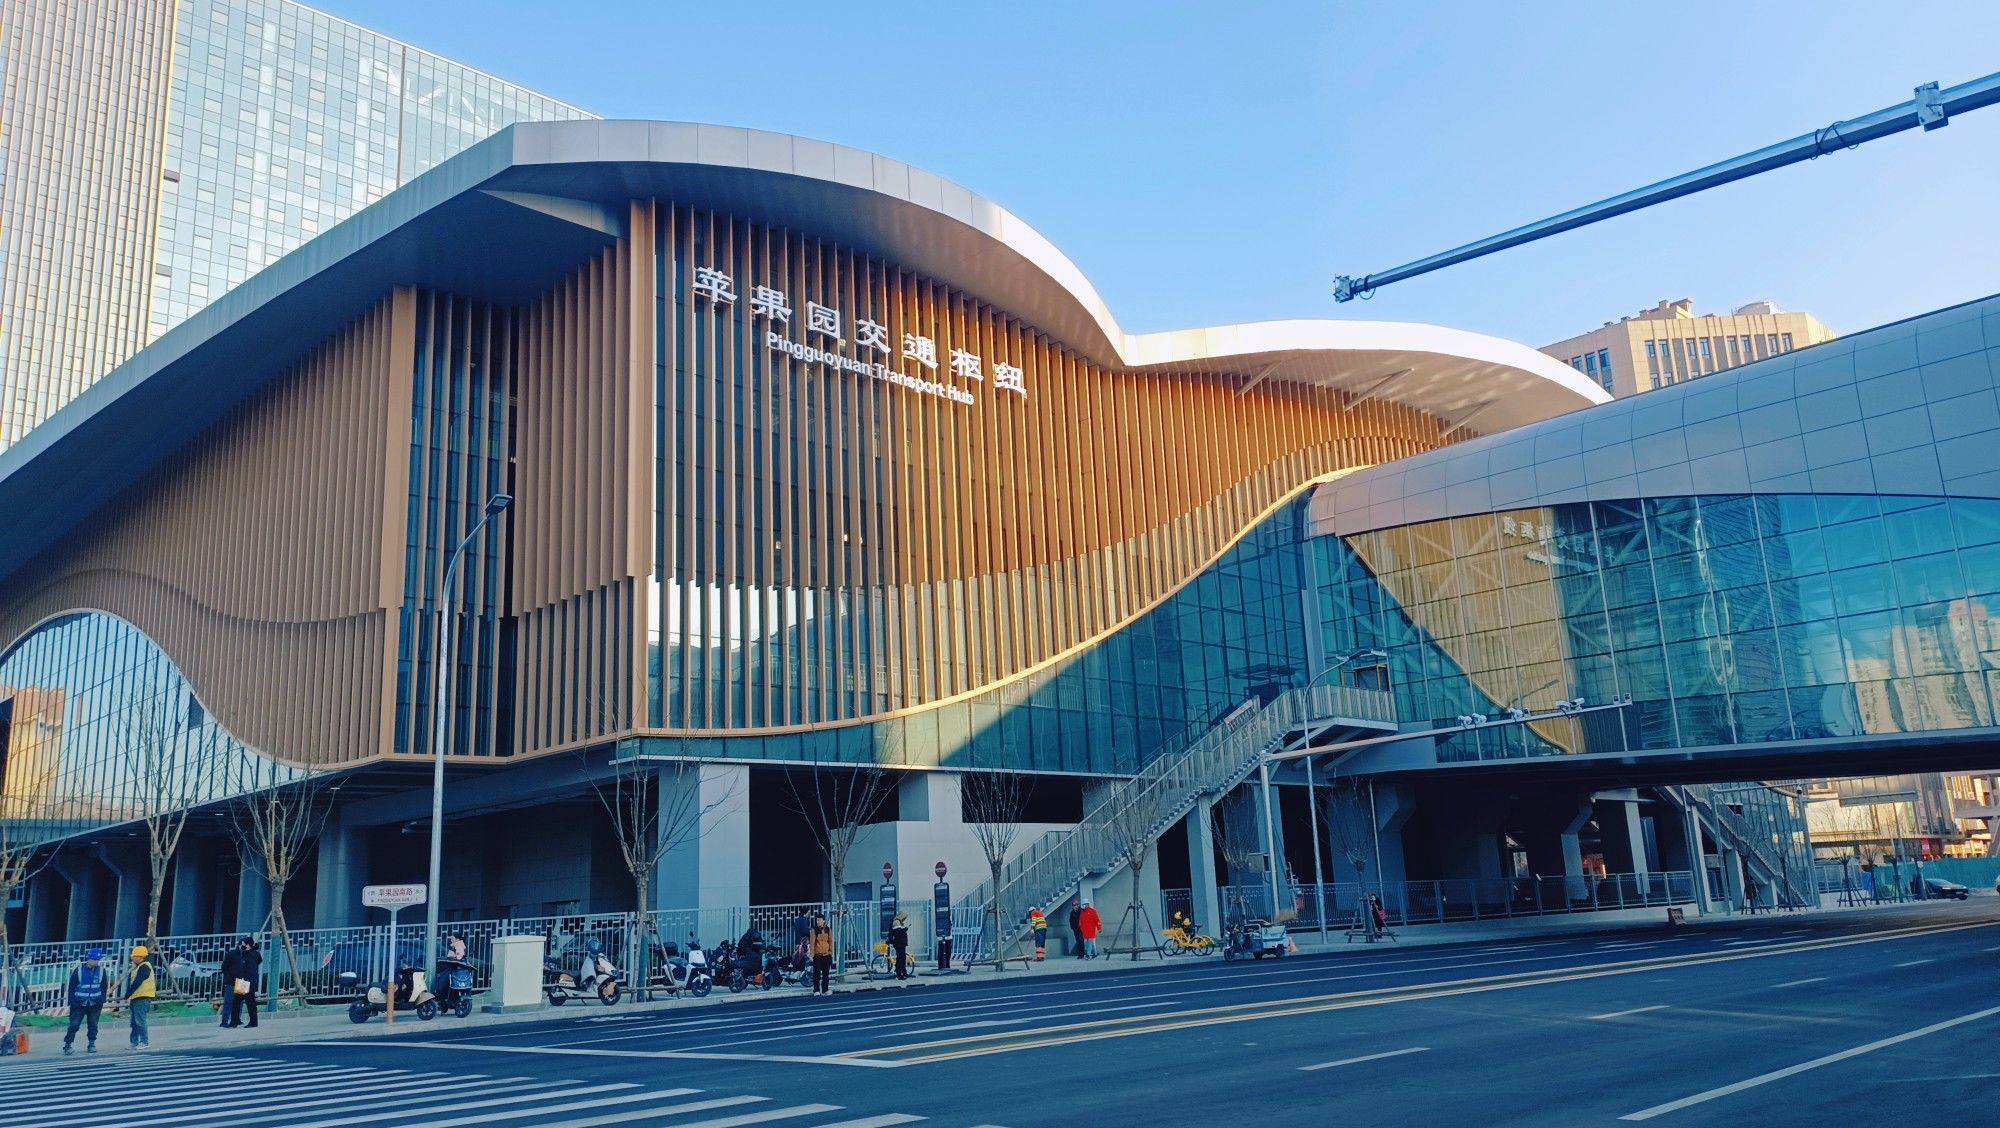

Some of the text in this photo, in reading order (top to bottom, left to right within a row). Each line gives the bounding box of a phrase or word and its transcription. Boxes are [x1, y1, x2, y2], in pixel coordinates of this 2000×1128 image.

[693, 266, 1027, 398] 苹果园交通枢纽
[766, 331, 872, 377] Pingguoyuan
[874, 363, 946, 399] Transport
